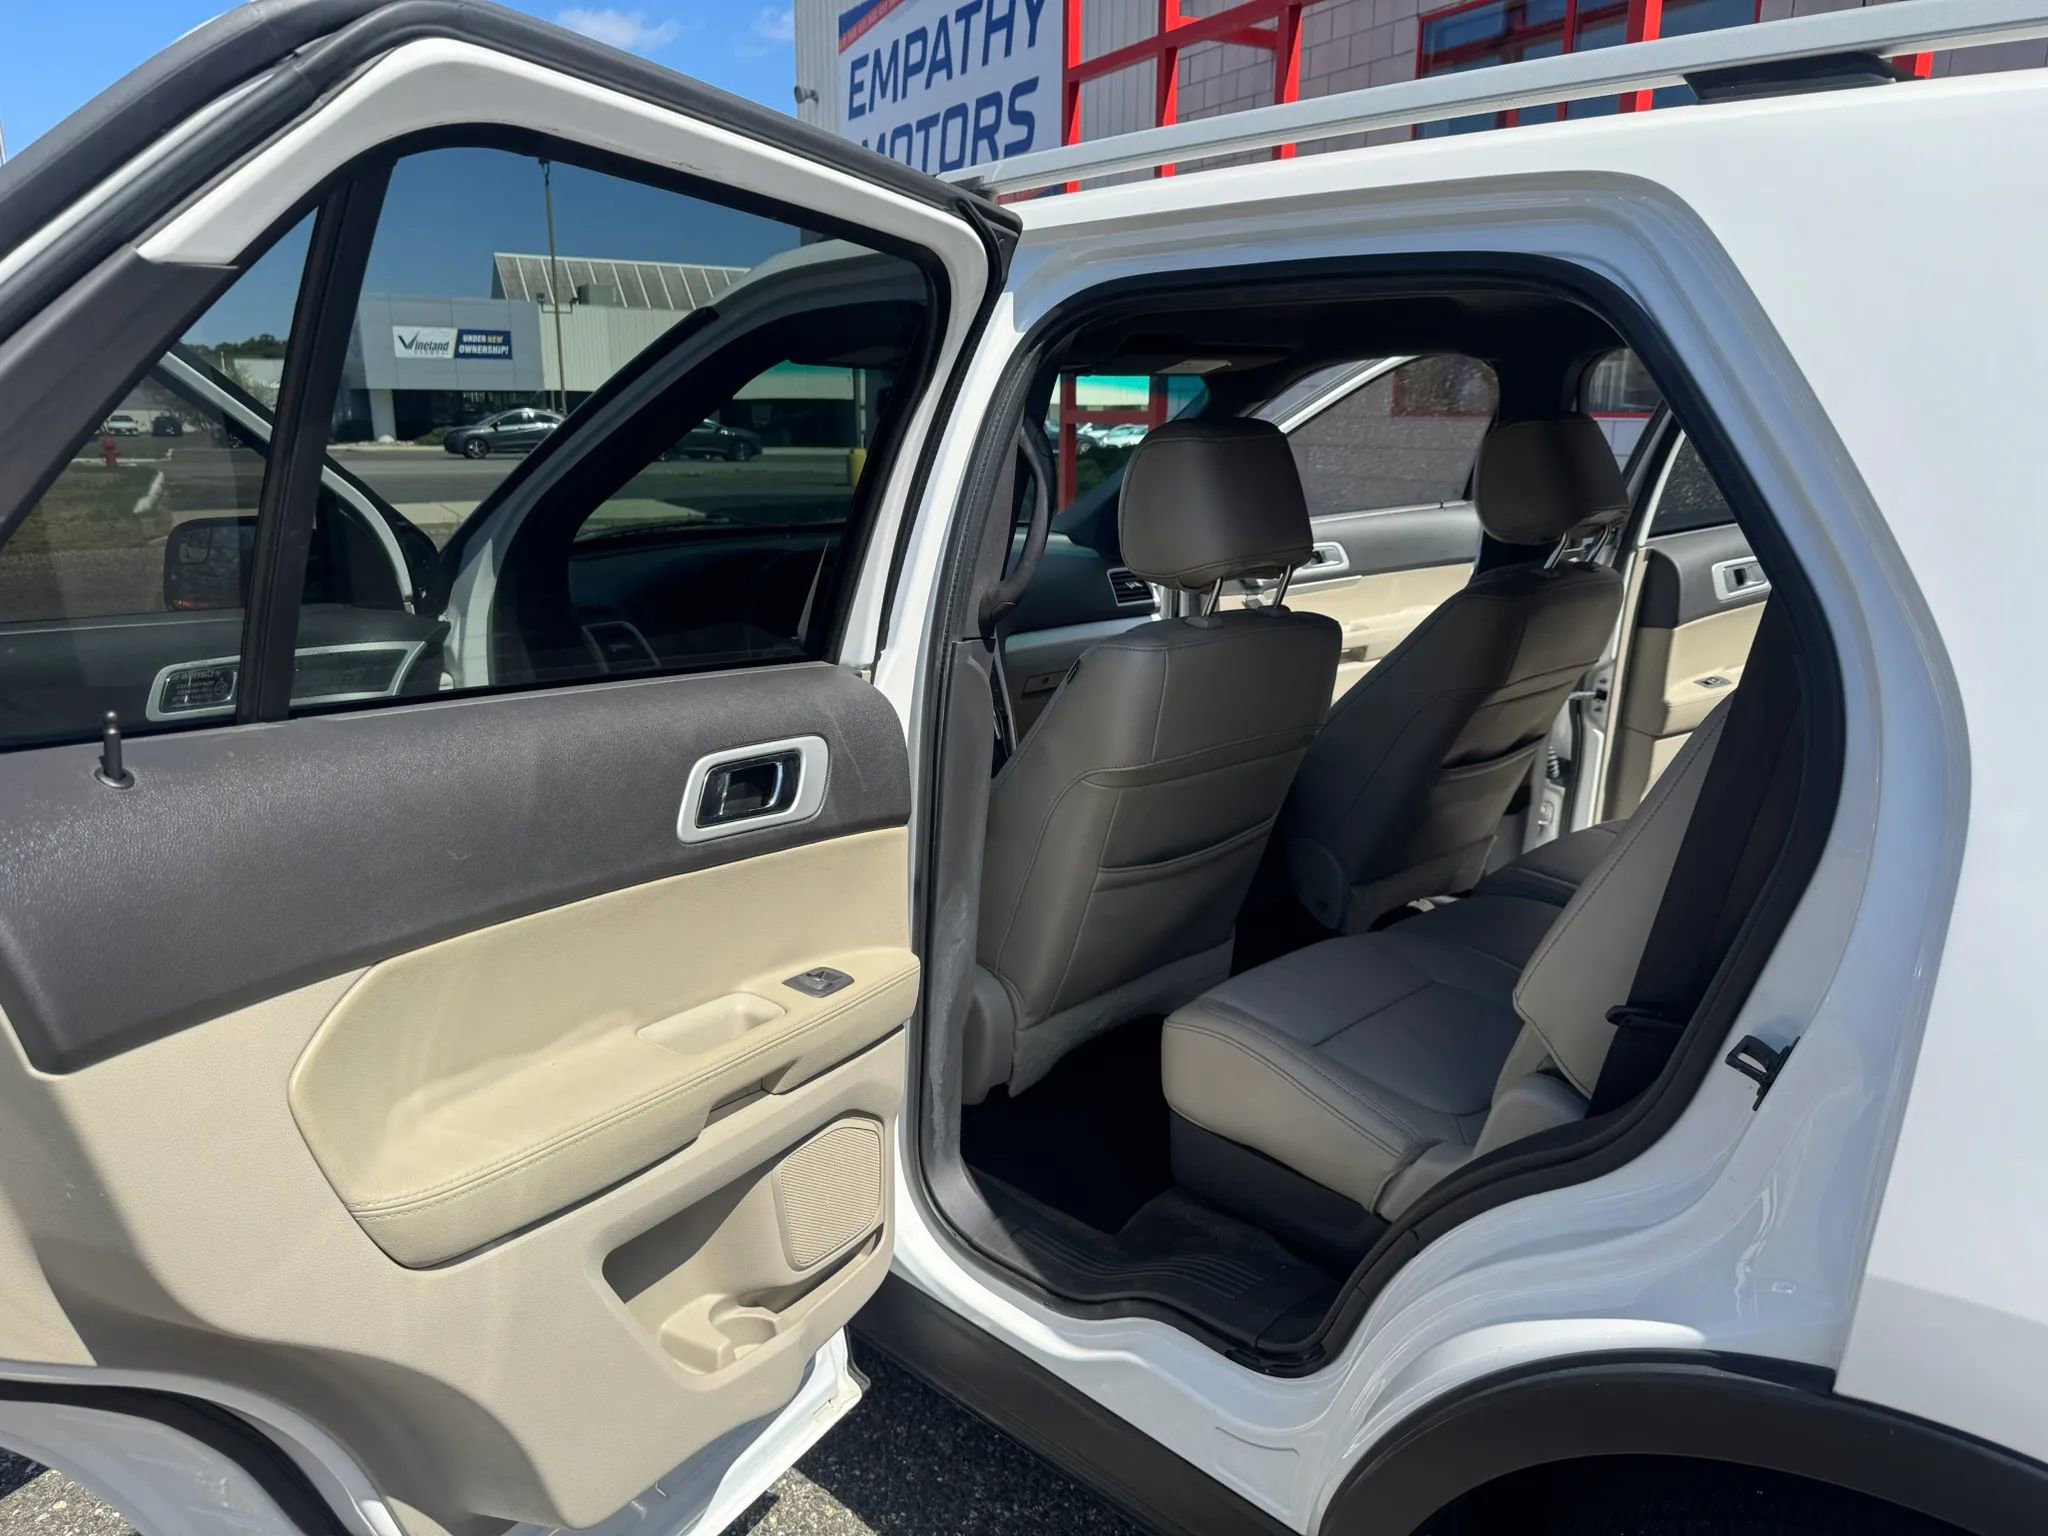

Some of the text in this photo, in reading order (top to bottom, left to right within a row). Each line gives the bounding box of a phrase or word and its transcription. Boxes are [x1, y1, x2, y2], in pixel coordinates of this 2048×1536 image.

[847, 0, 1044, 121] EMPATHY
[861, 75, 1040, 173] OTORS
[398, 331, 450, 352] Vineland
[458, 344, 509, 355] OWNERSHIP!
[462, 334, 504, 344] UNDER NEW
